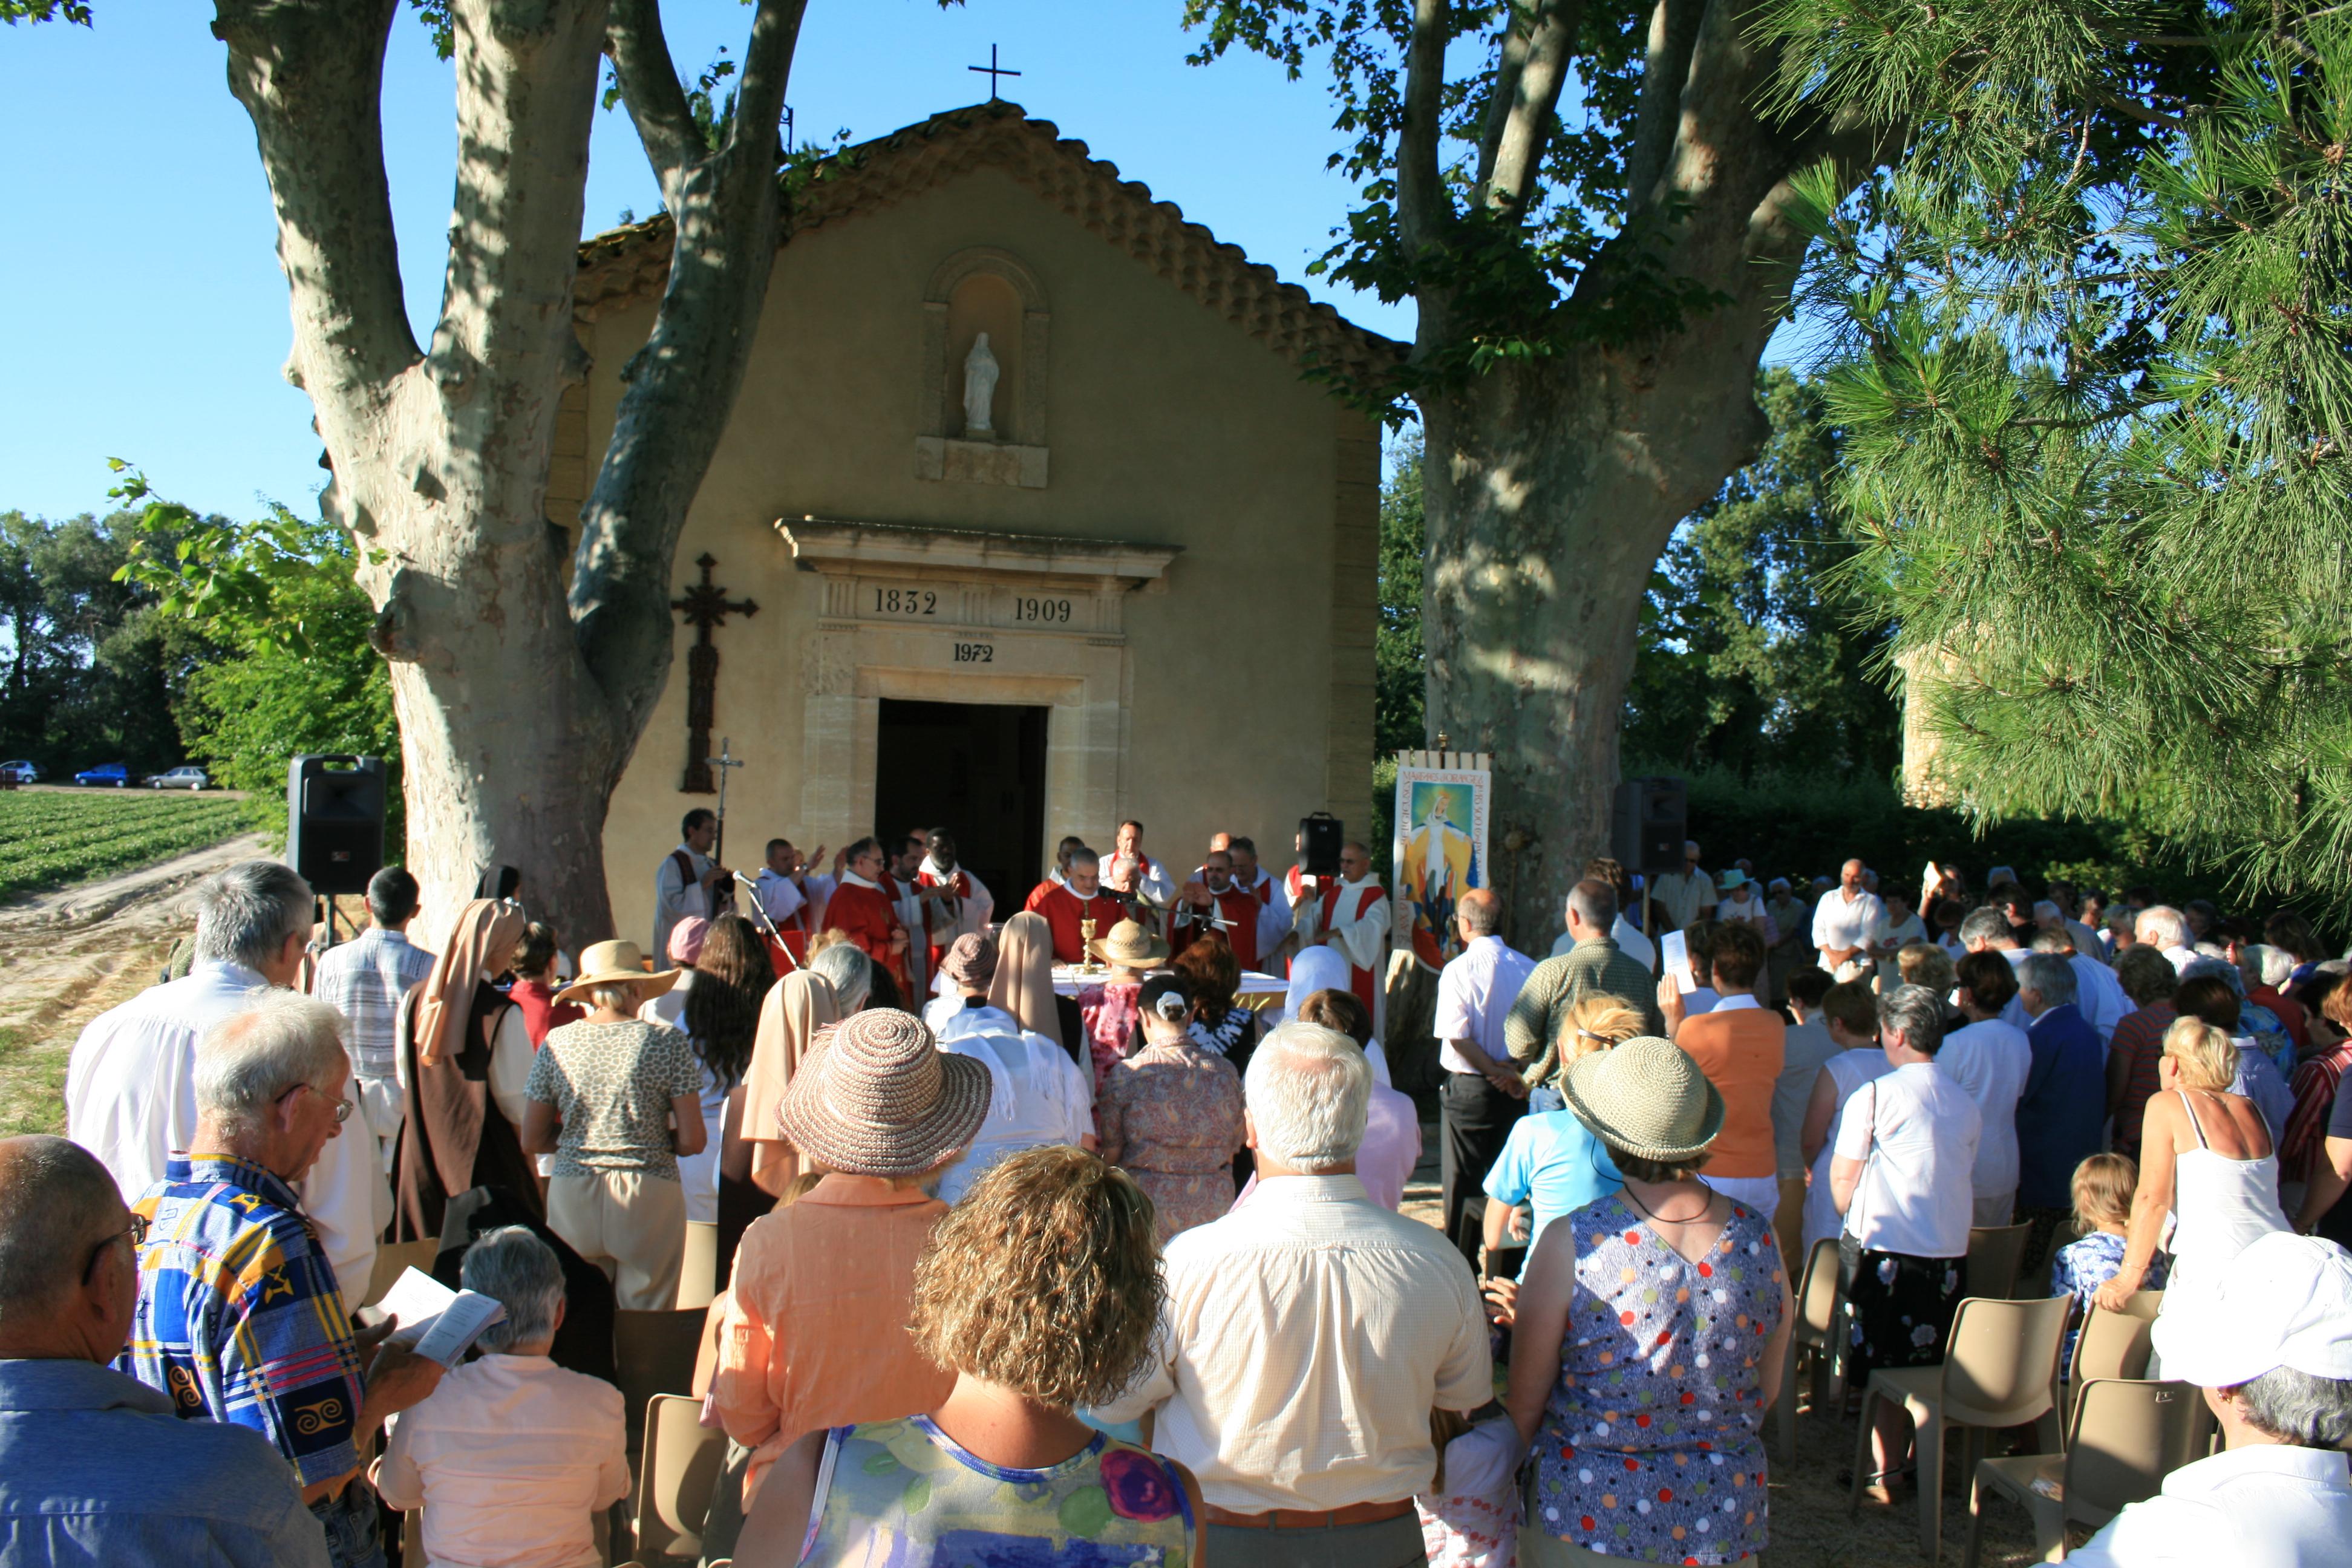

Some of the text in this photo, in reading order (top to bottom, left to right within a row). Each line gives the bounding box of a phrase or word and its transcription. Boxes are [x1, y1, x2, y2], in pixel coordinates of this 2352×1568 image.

[875, 589, 936, 615] 1832
[1016, 598, 1070, 622] 1909
[954, 643, 993, 662] 1972
